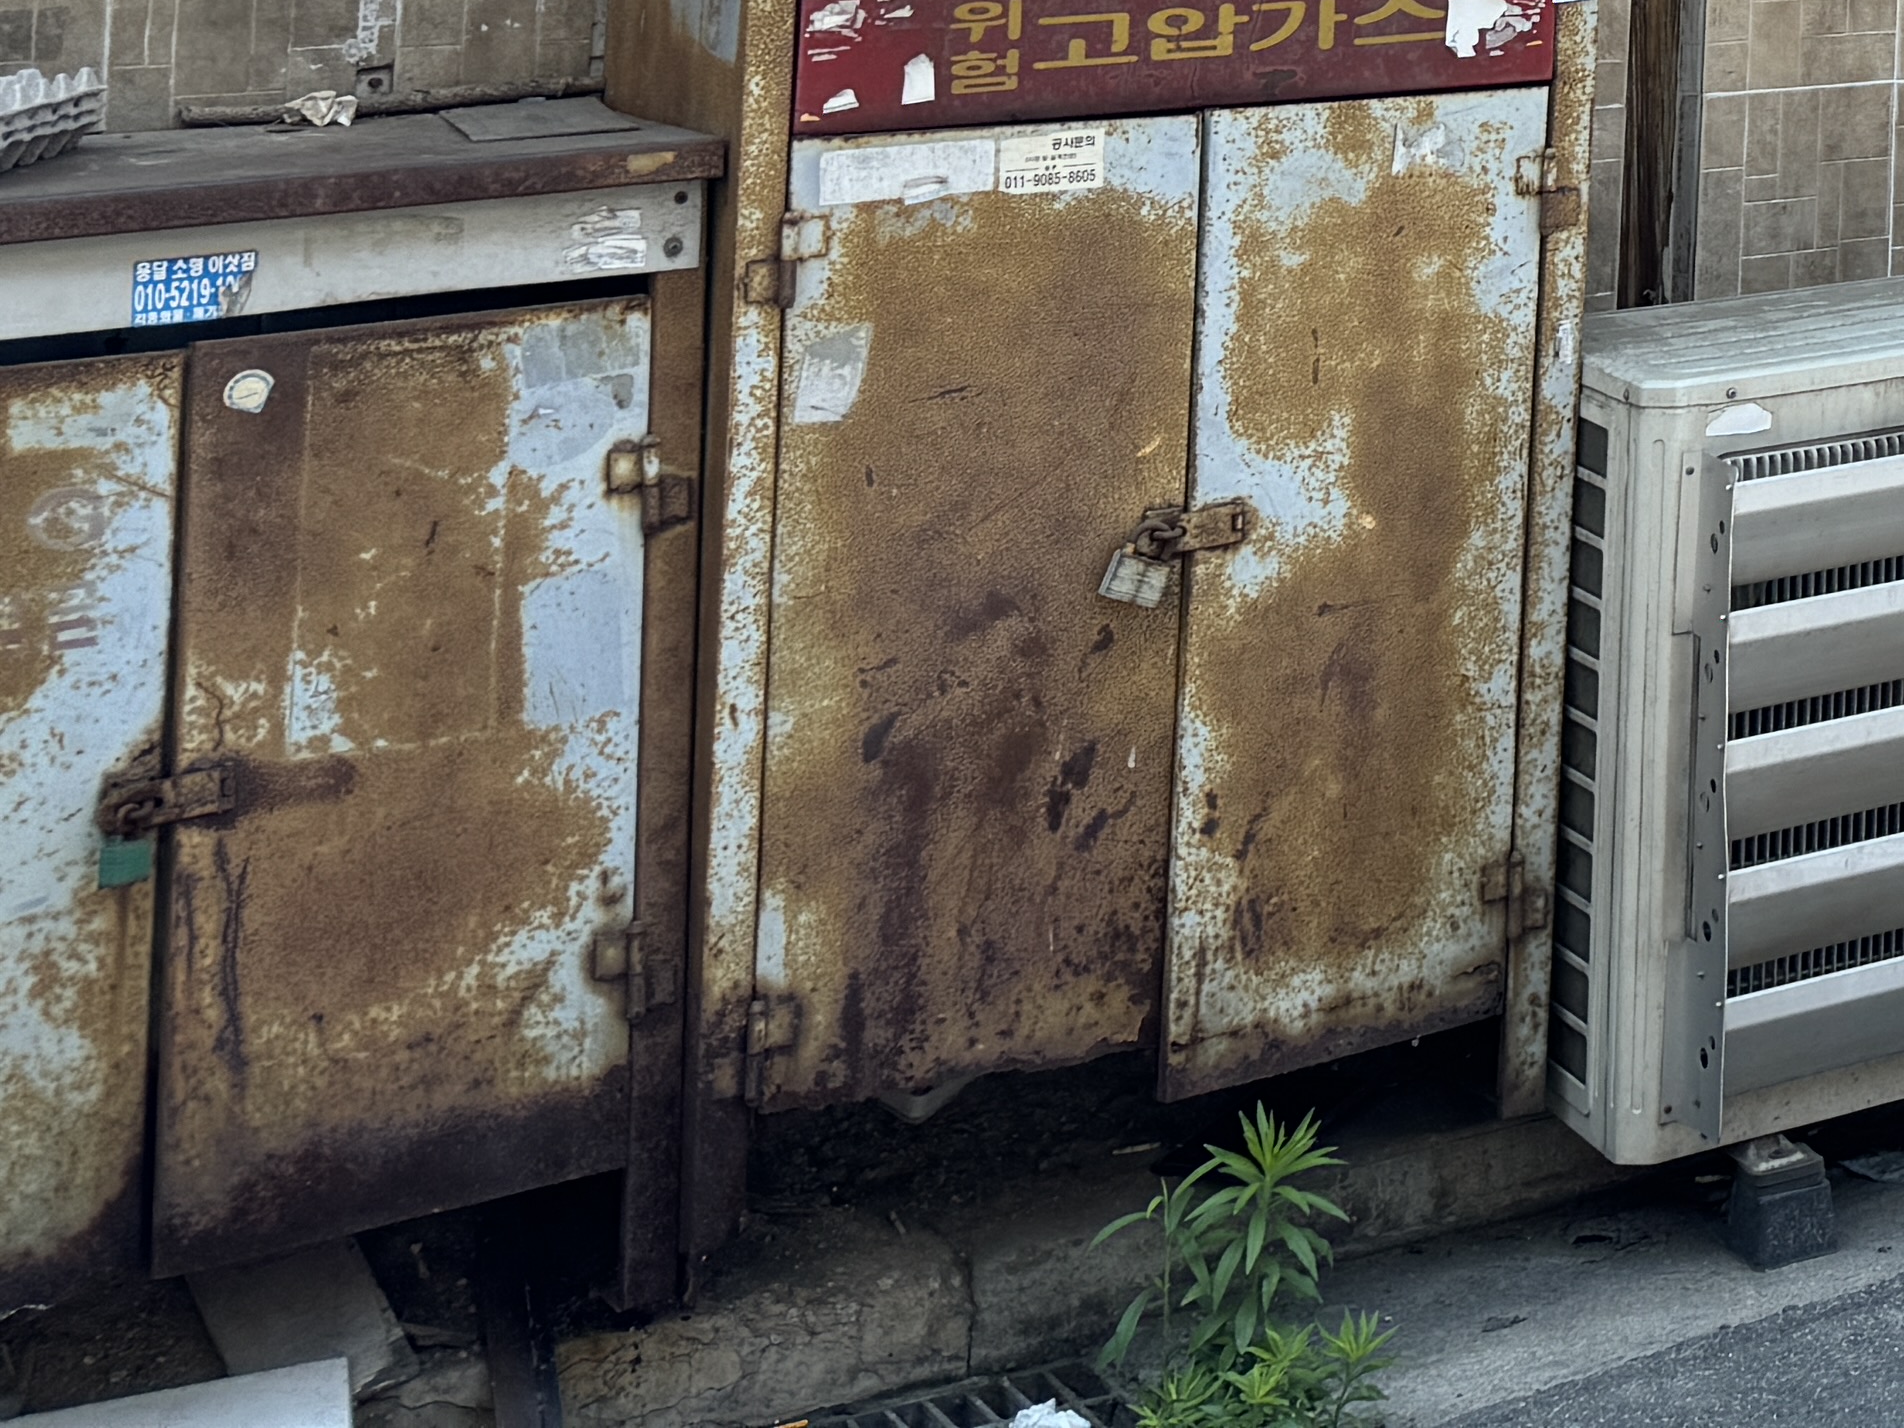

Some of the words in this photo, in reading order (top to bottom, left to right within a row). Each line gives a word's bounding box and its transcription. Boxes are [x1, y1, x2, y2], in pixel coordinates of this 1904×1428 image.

[1052, 135, 1096, 150] 공사문의
[135, 261, 168, 283] 용달
[207, 251, 257, 274] 이삿짐
